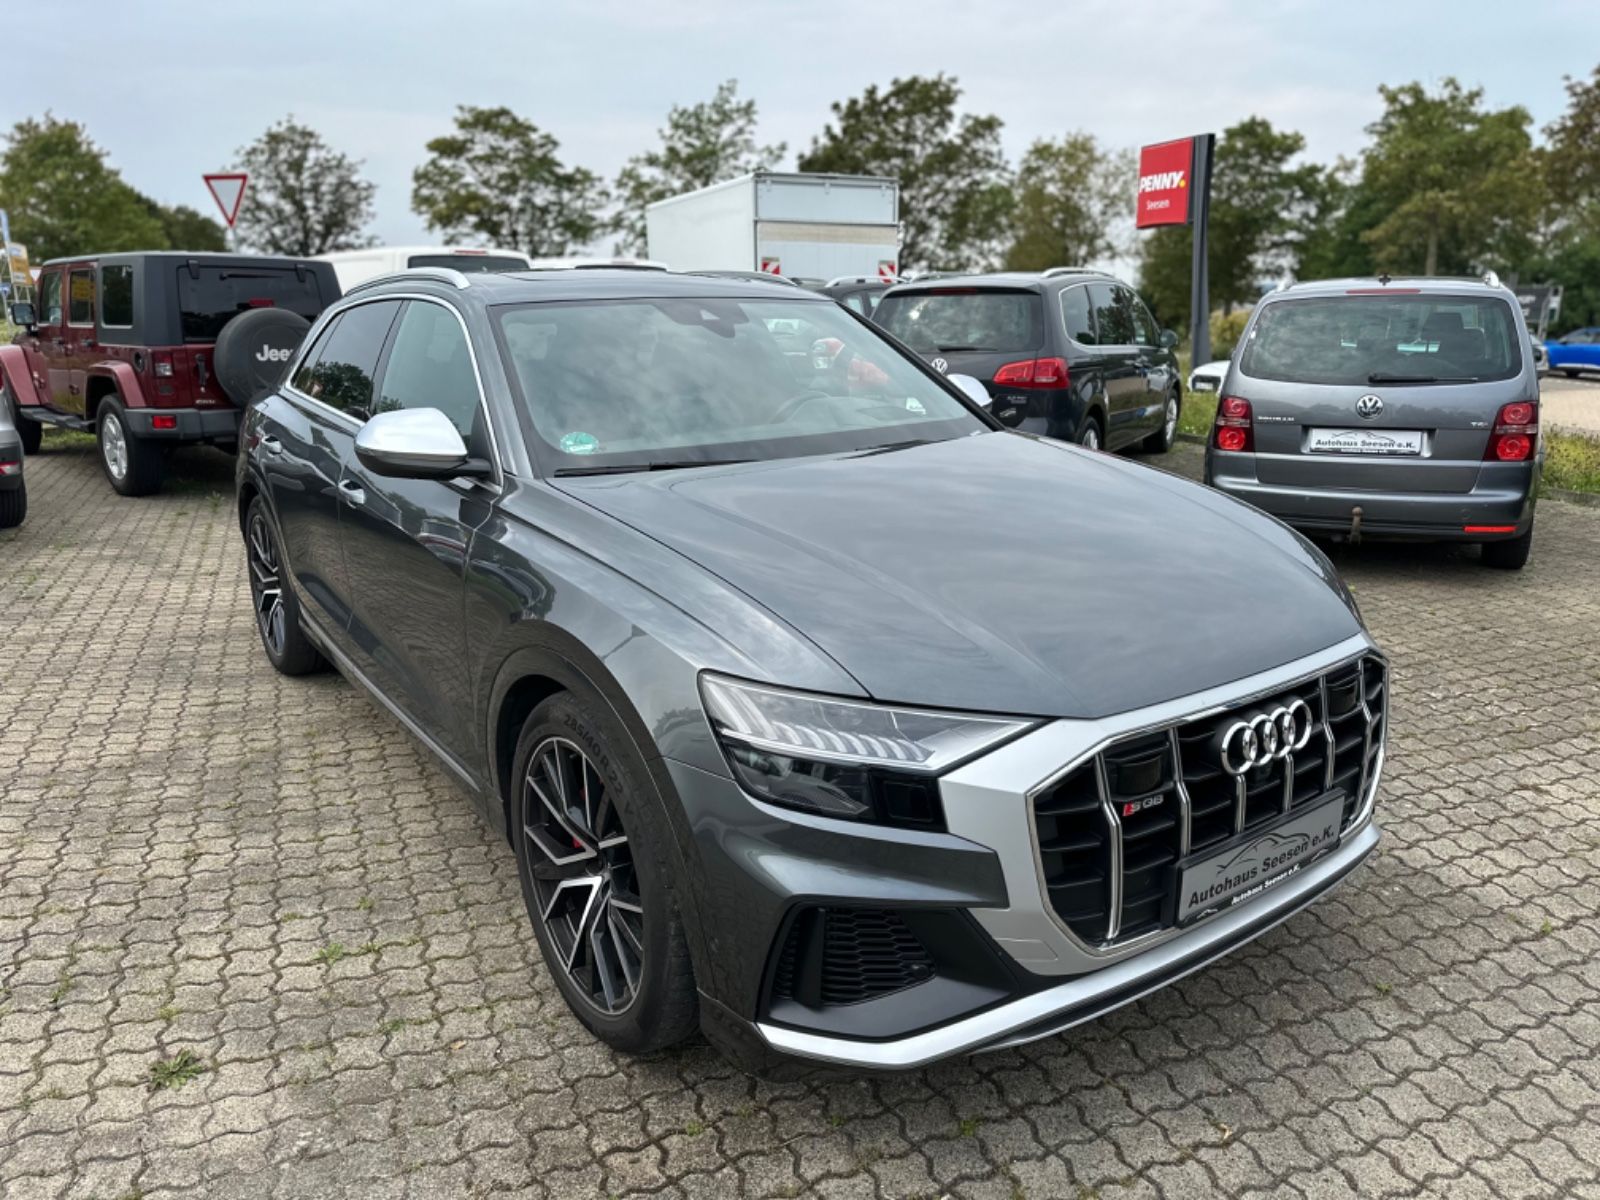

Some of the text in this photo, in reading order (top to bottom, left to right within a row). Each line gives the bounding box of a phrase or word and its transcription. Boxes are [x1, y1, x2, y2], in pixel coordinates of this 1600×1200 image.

[256, 344, 294, 361] Jee
[1315, 438, 1358, 447] Autohaus
[1360, 439, 1396, 448] Seesen
[1188, 824, 1335, 908] Autohaus Seesen e.K.
